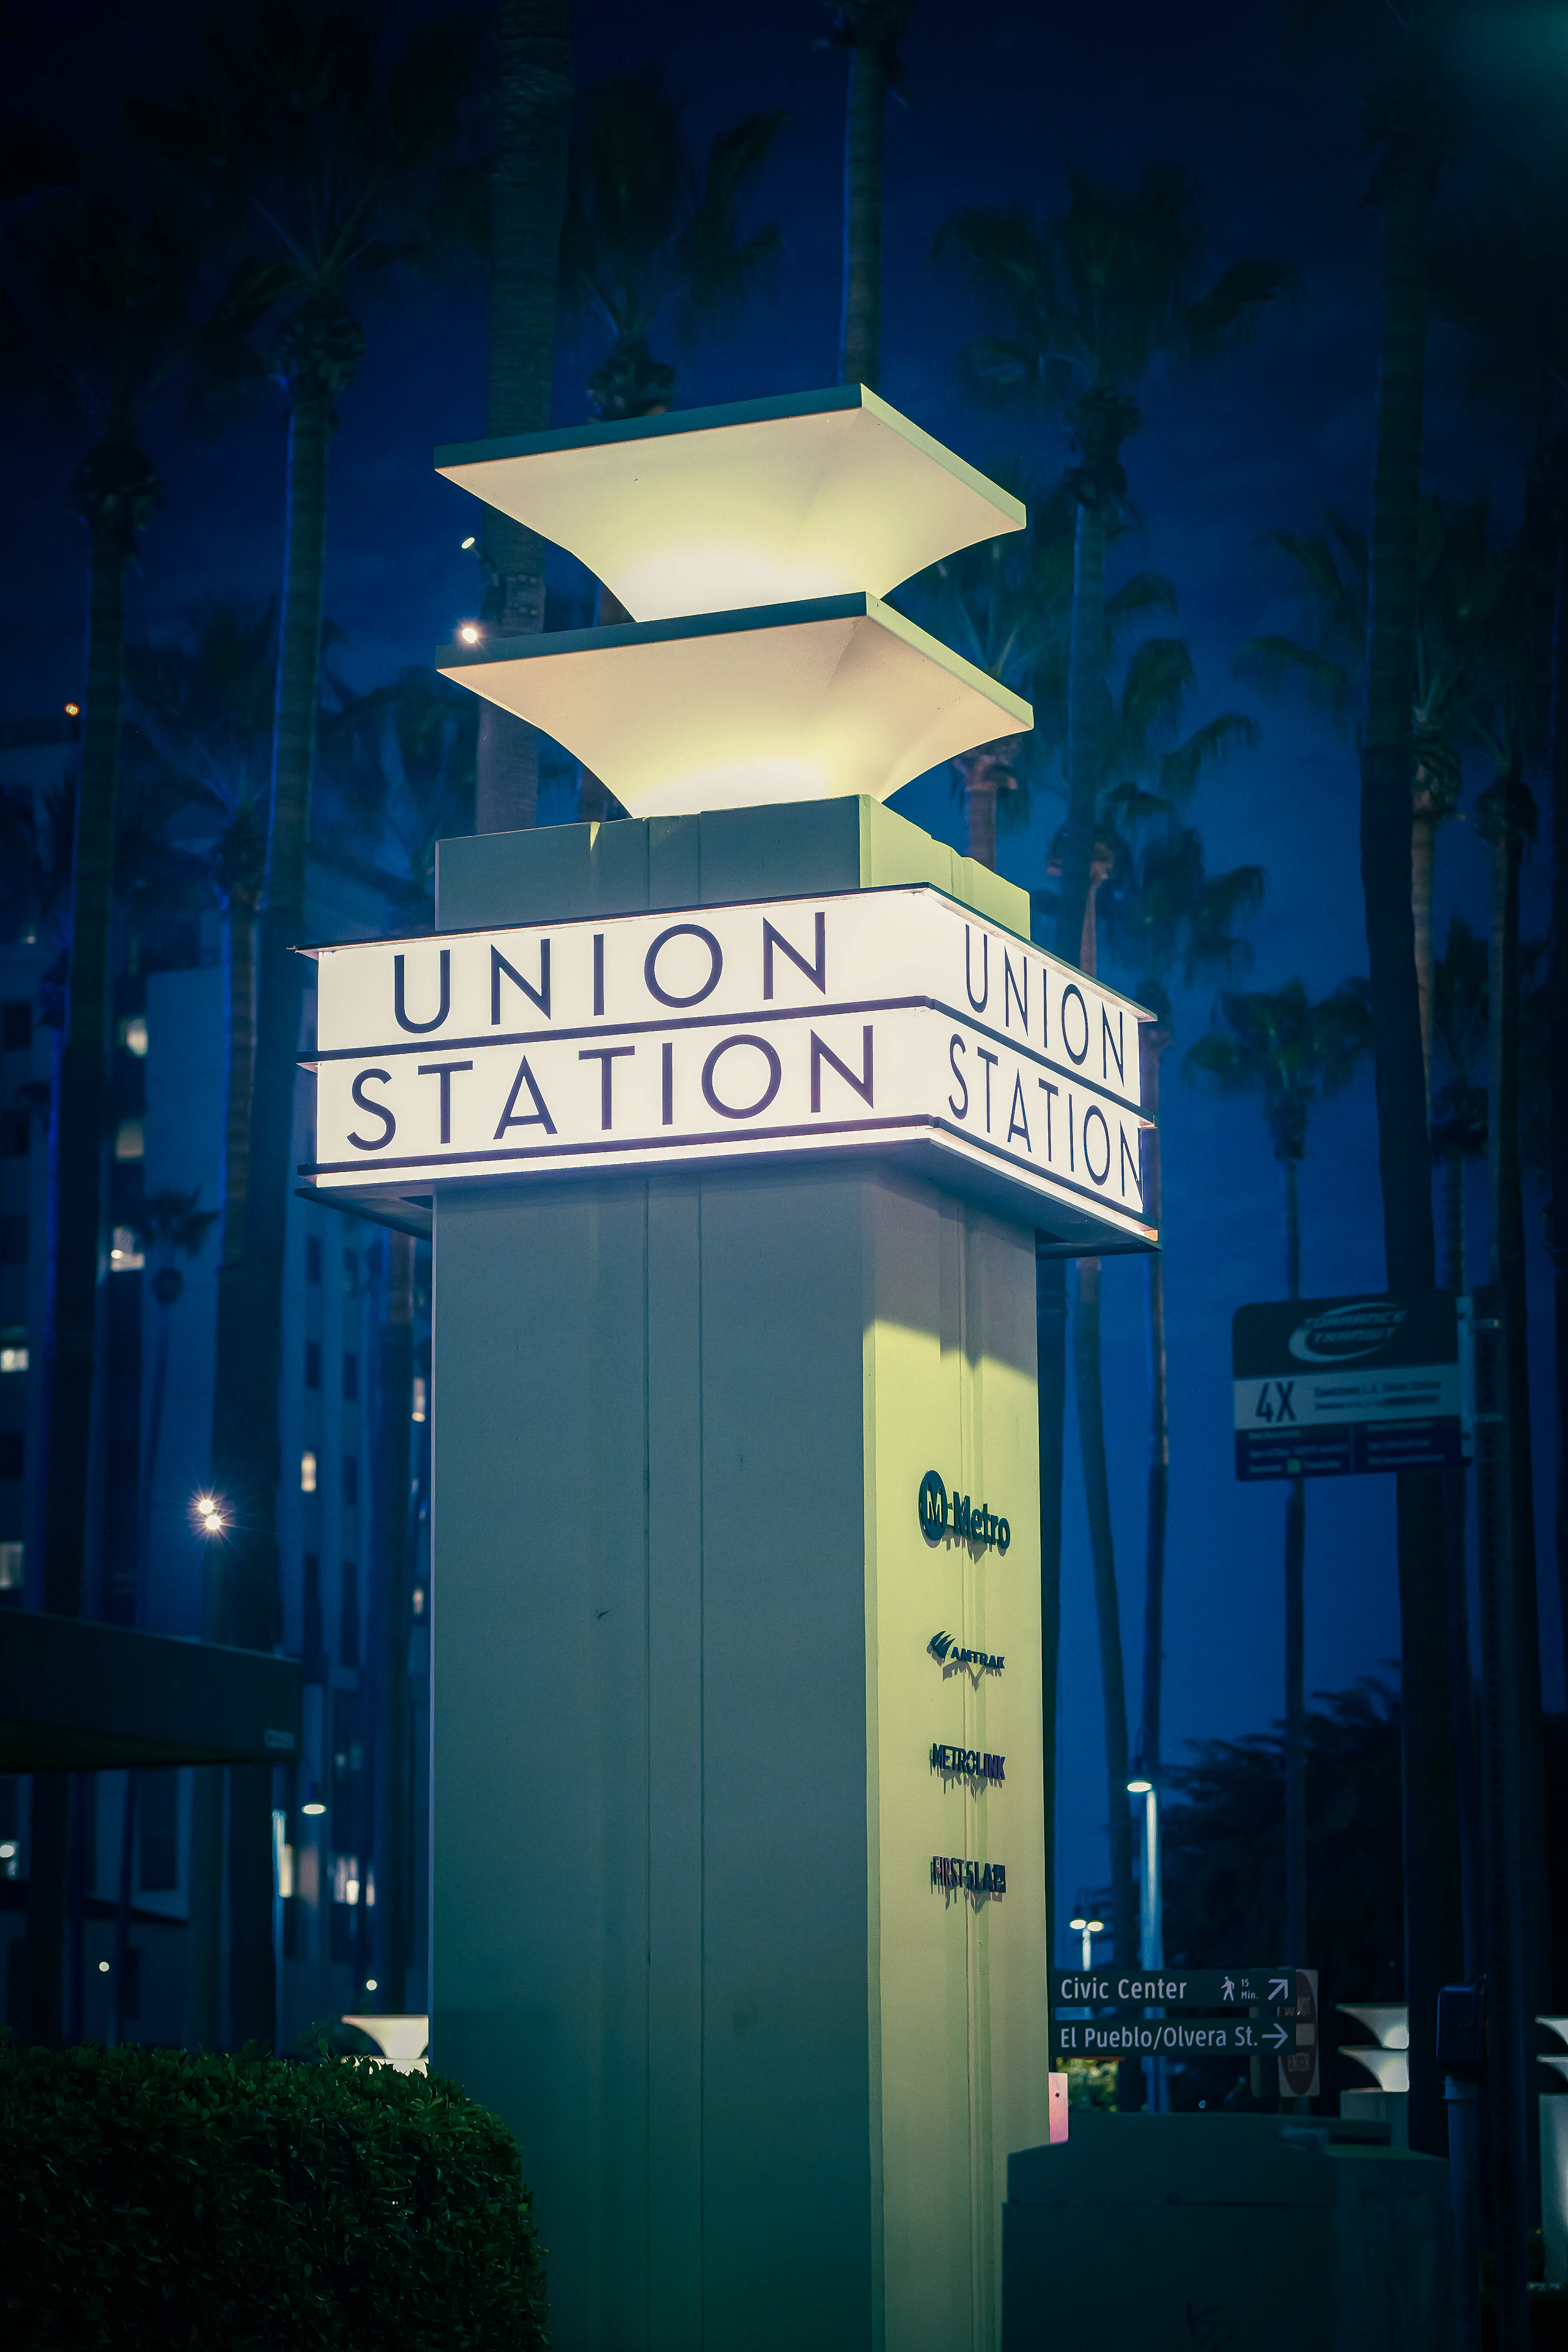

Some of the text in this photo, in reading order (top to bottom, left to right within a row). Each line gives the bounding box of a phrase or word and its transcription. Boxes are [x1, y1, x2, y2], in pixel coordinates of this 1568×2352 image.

[394, 911, 826, 1034] UNION
[965, 924, 1125, 1087] UNION
[346, 1025, 874, 1151] STATION
[948, 1033, 1144, 1207] STATION
[1255, 1381, 1297, 1423] 4X
[953, 1491, 1011, 1549] Metro
[951, 1646, 1005, 1669] AMTRAK
[932, 1743, 1006, 1780] METROLINK
[933, 1856, 964, 1887] FIRST
[1061, 1977, 1187, 1999] Civic Center
[1241, 1978, 1250, 1987] 15
[1241, 1990, 1259, 2000] Min.
[1061, 2026, 1258, 2050] El Pueblo/Olvera St.
